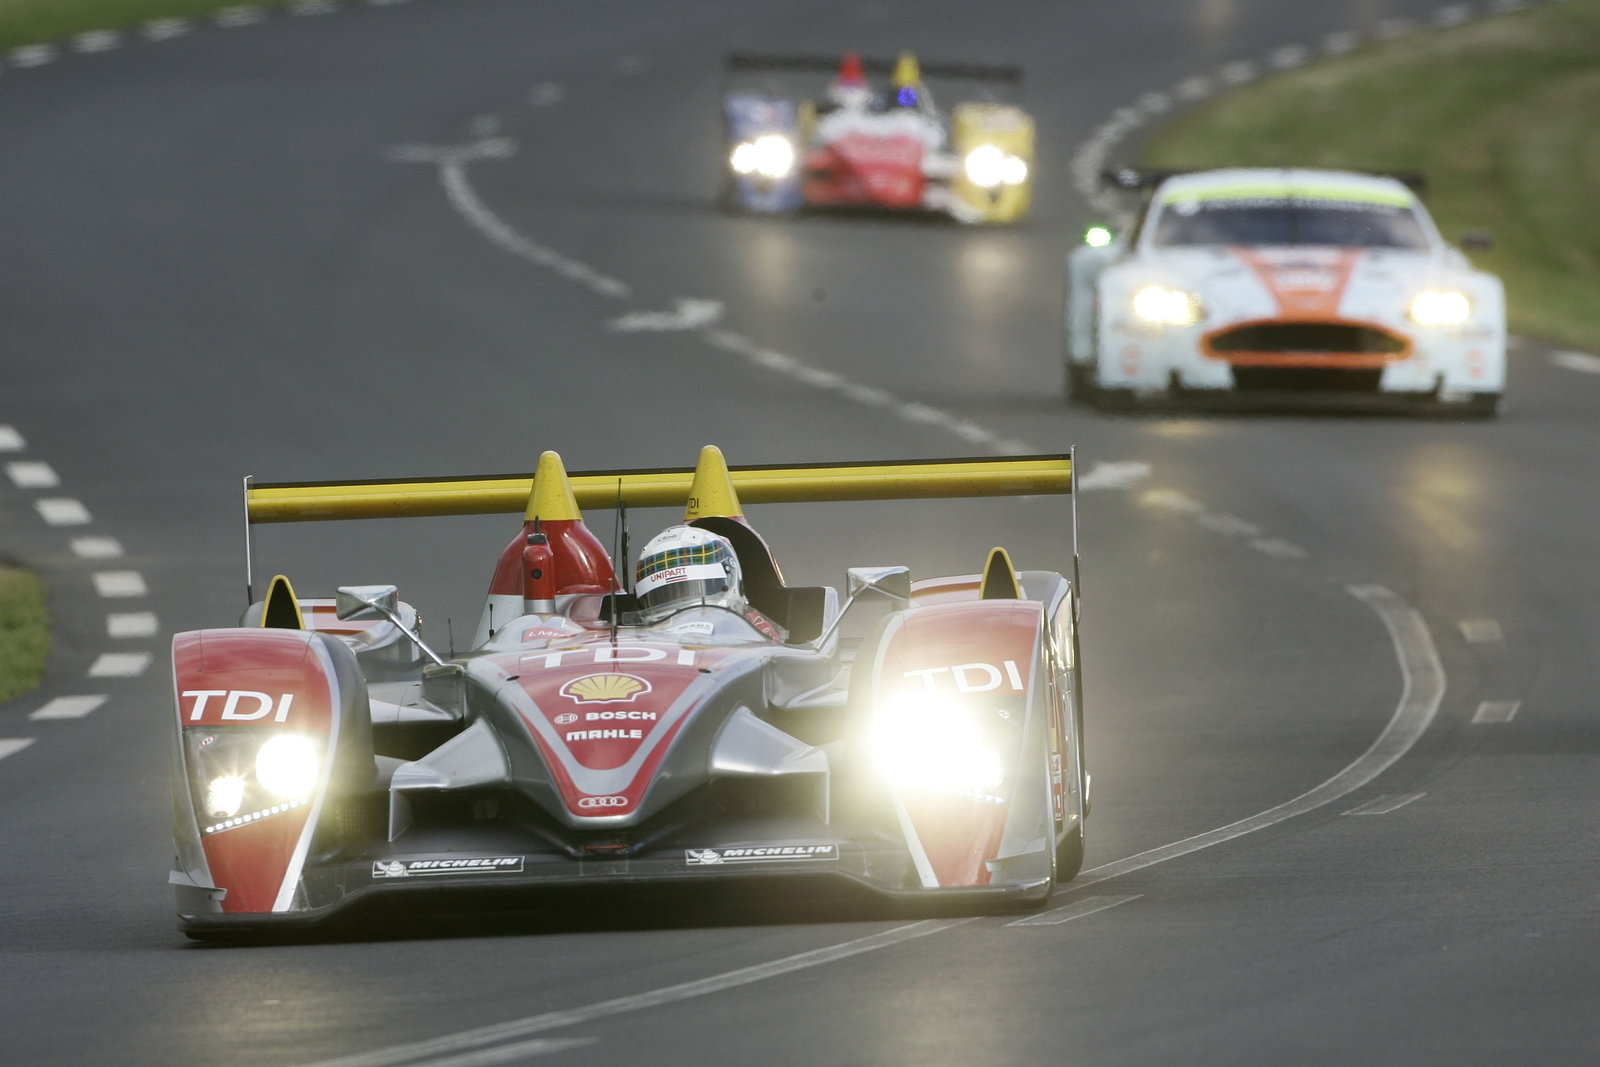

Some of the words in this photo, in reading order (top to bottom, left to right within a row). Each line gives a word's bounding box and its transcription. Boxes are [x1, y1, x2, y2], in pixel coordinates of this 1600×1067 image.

[650, 567, 687, 583] UNIPART
[521, 646, 697, 669] TDI
[903, 660, 1024, 694] TDI
[181, 689, 294, 723] TDI
[585, 710, 657, 722] BOSCH
[565, 728, 643, 742] MAHLE
[722, 844, 834, 858] MICHELIN
[408, 856, 520, 870] MICHELIN
